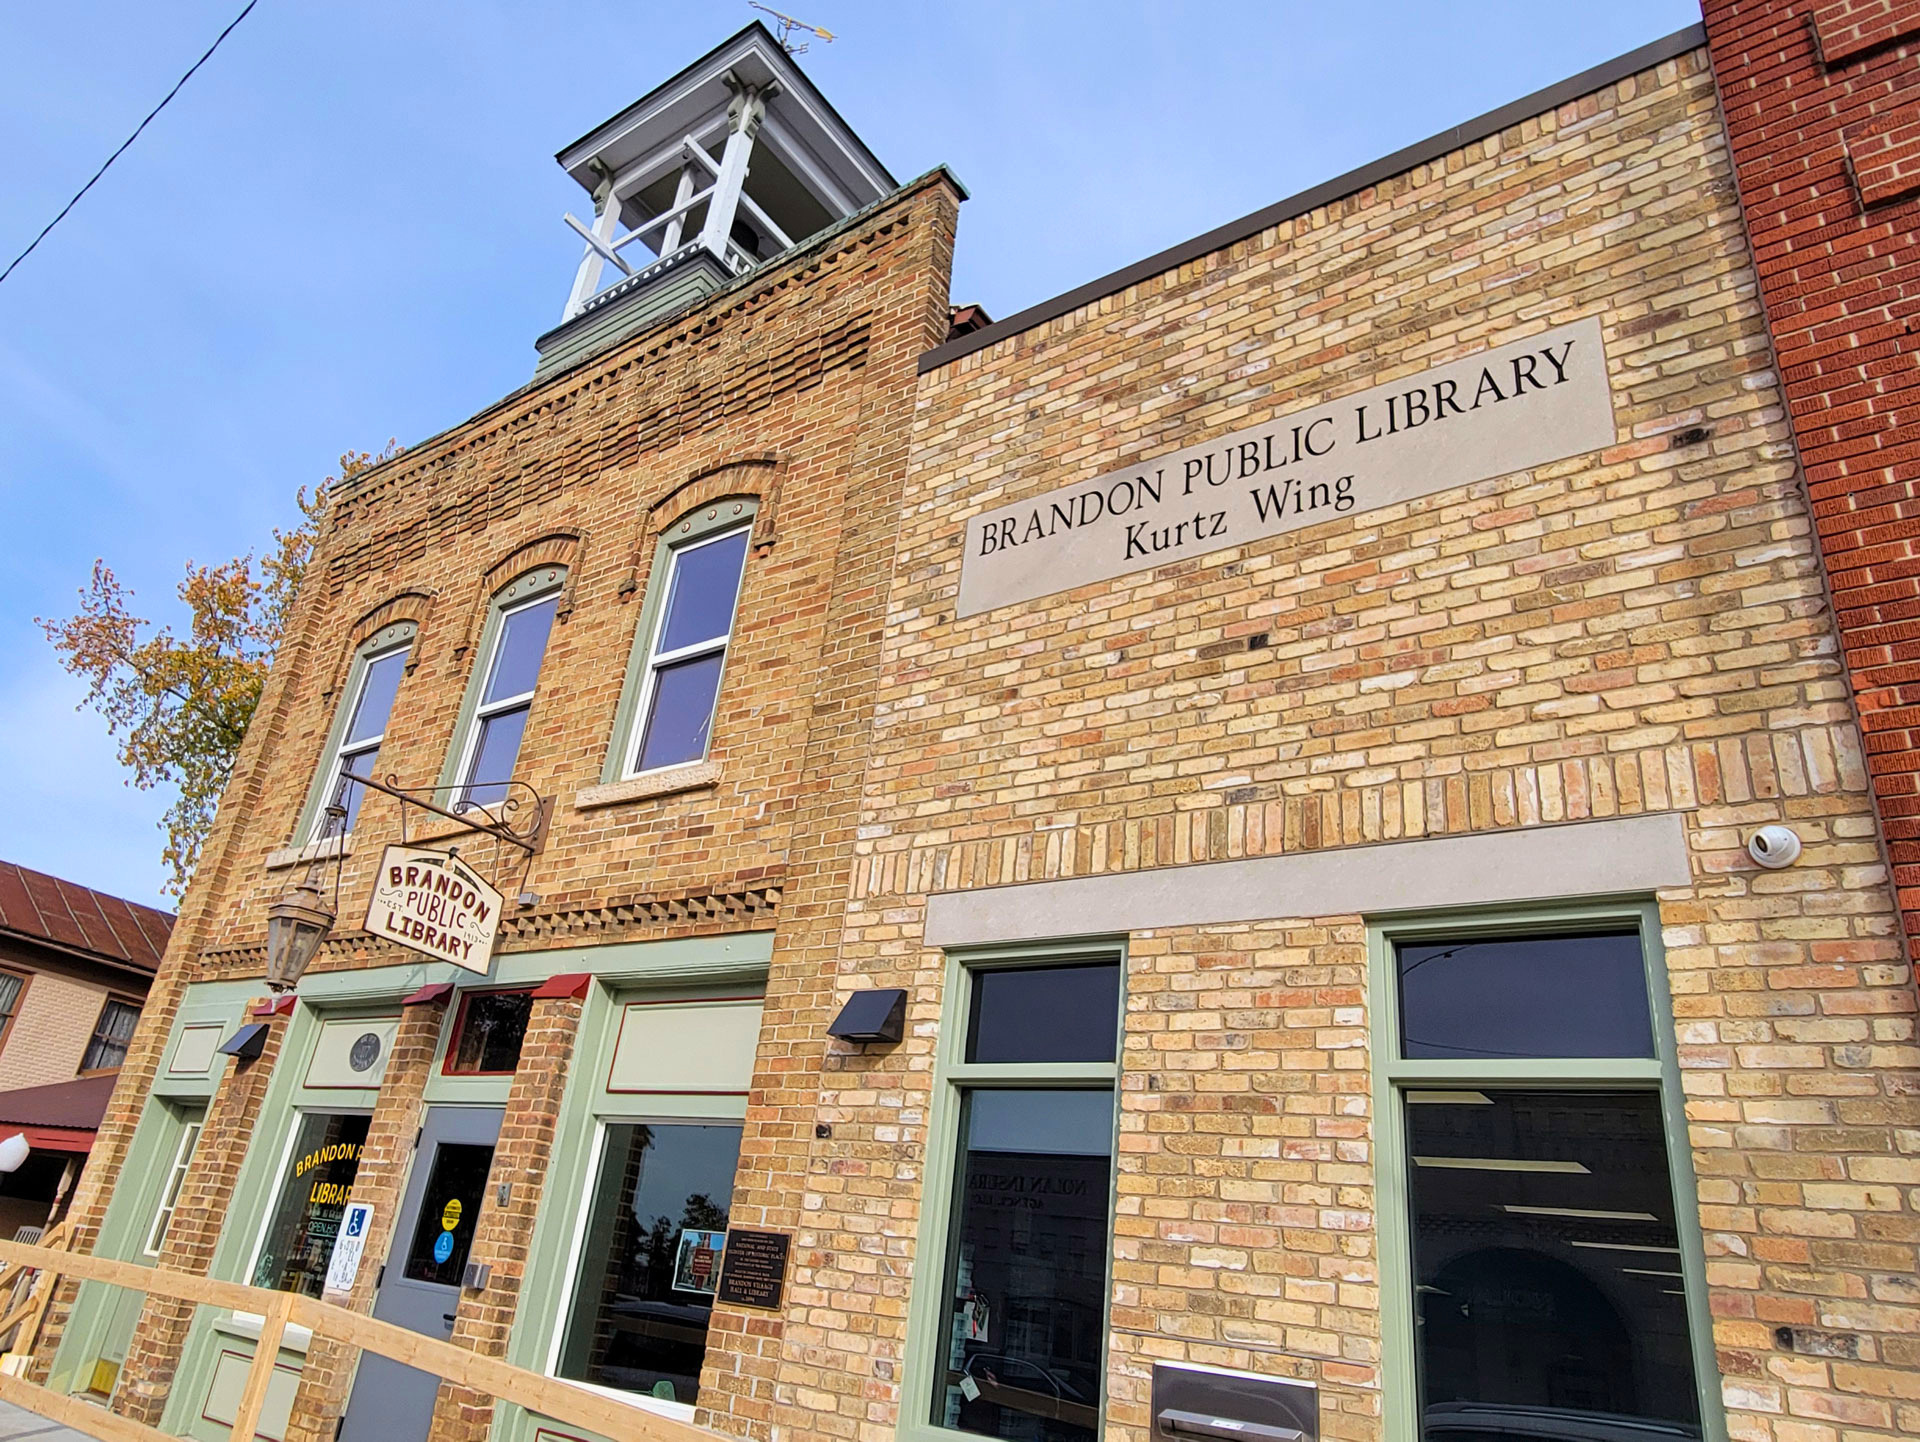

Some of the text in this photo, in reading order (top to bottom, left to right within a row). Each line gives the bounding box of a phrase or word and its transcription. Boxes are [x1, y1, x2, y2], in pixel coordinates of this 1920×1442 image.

[979, 341, 1576, 556] BRANDON PUBLIC LIBRARY
[1123, 475, 1356, 560] Kurtz Wing
[390, 866, 490, 923] BRANDON
[407, 892, 467, 929] PUBLIC
[385, 912, 473, 959] LIBRARY
[296, 1144, 356, 1178] BRANDON
